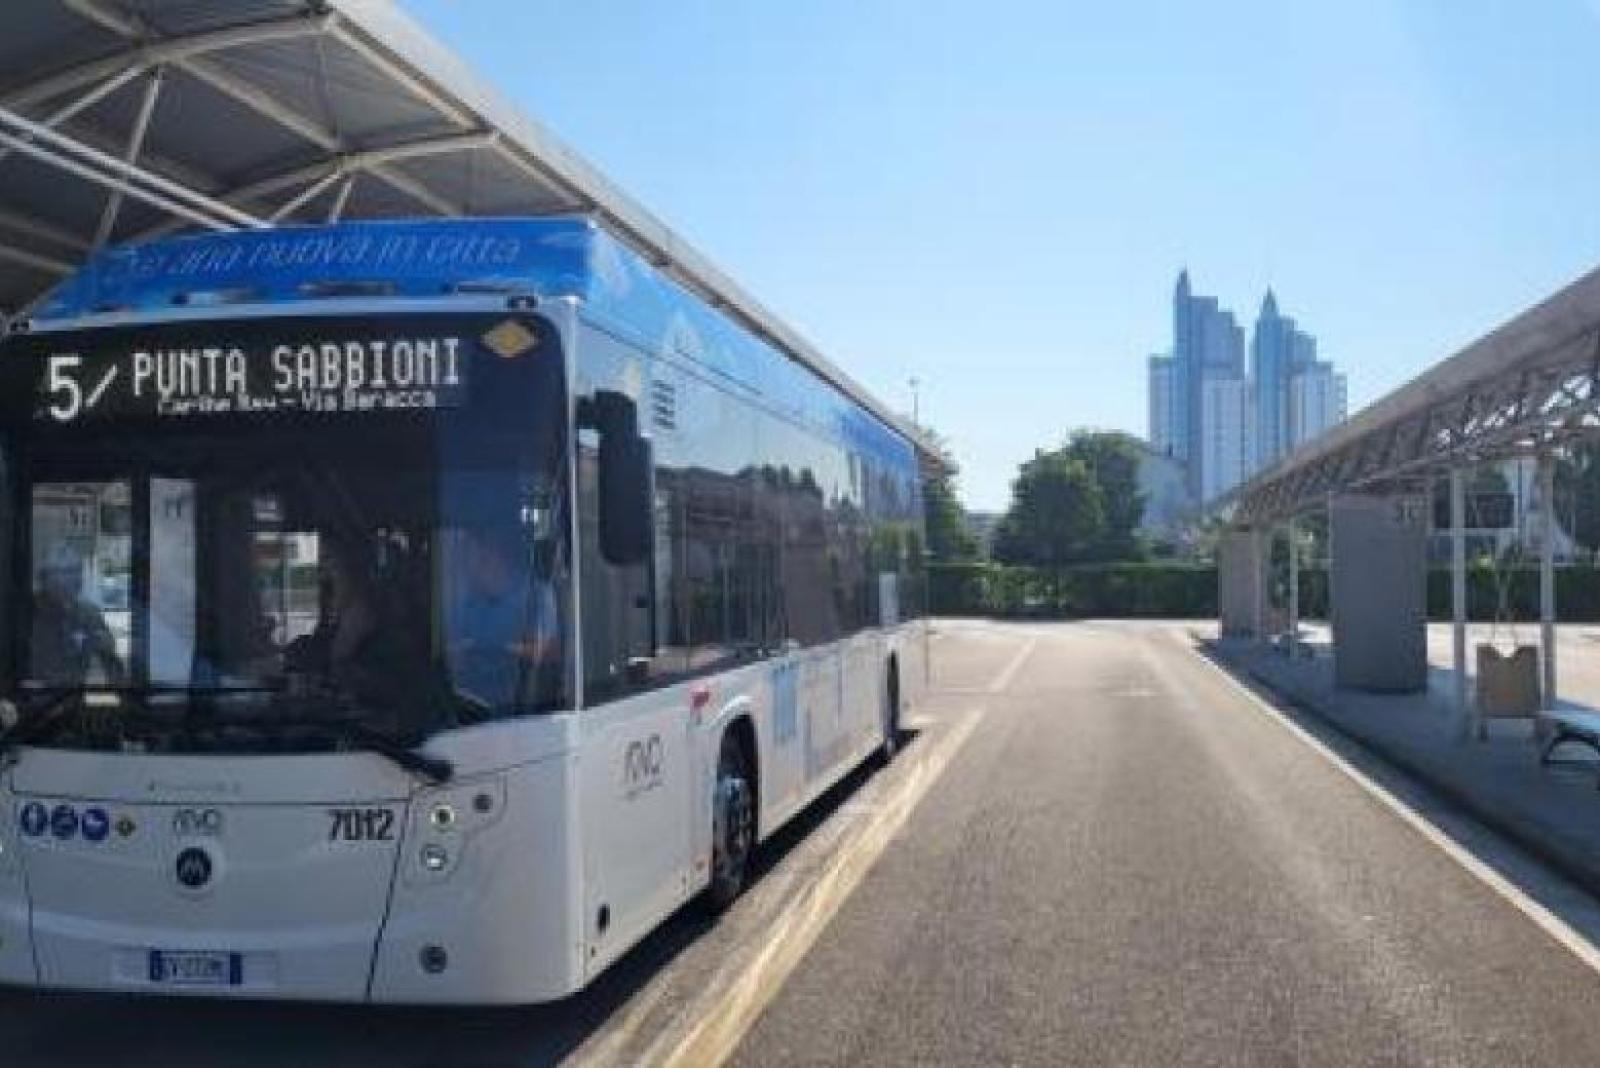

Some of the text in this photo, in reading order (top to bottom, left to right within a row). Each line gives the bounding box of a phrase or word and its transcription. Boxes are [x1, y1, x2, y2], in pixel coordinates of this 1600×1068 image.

[133, 338, 459, 397] PUNTA SABBIONI
[327, 808, 395, 841] 7012
